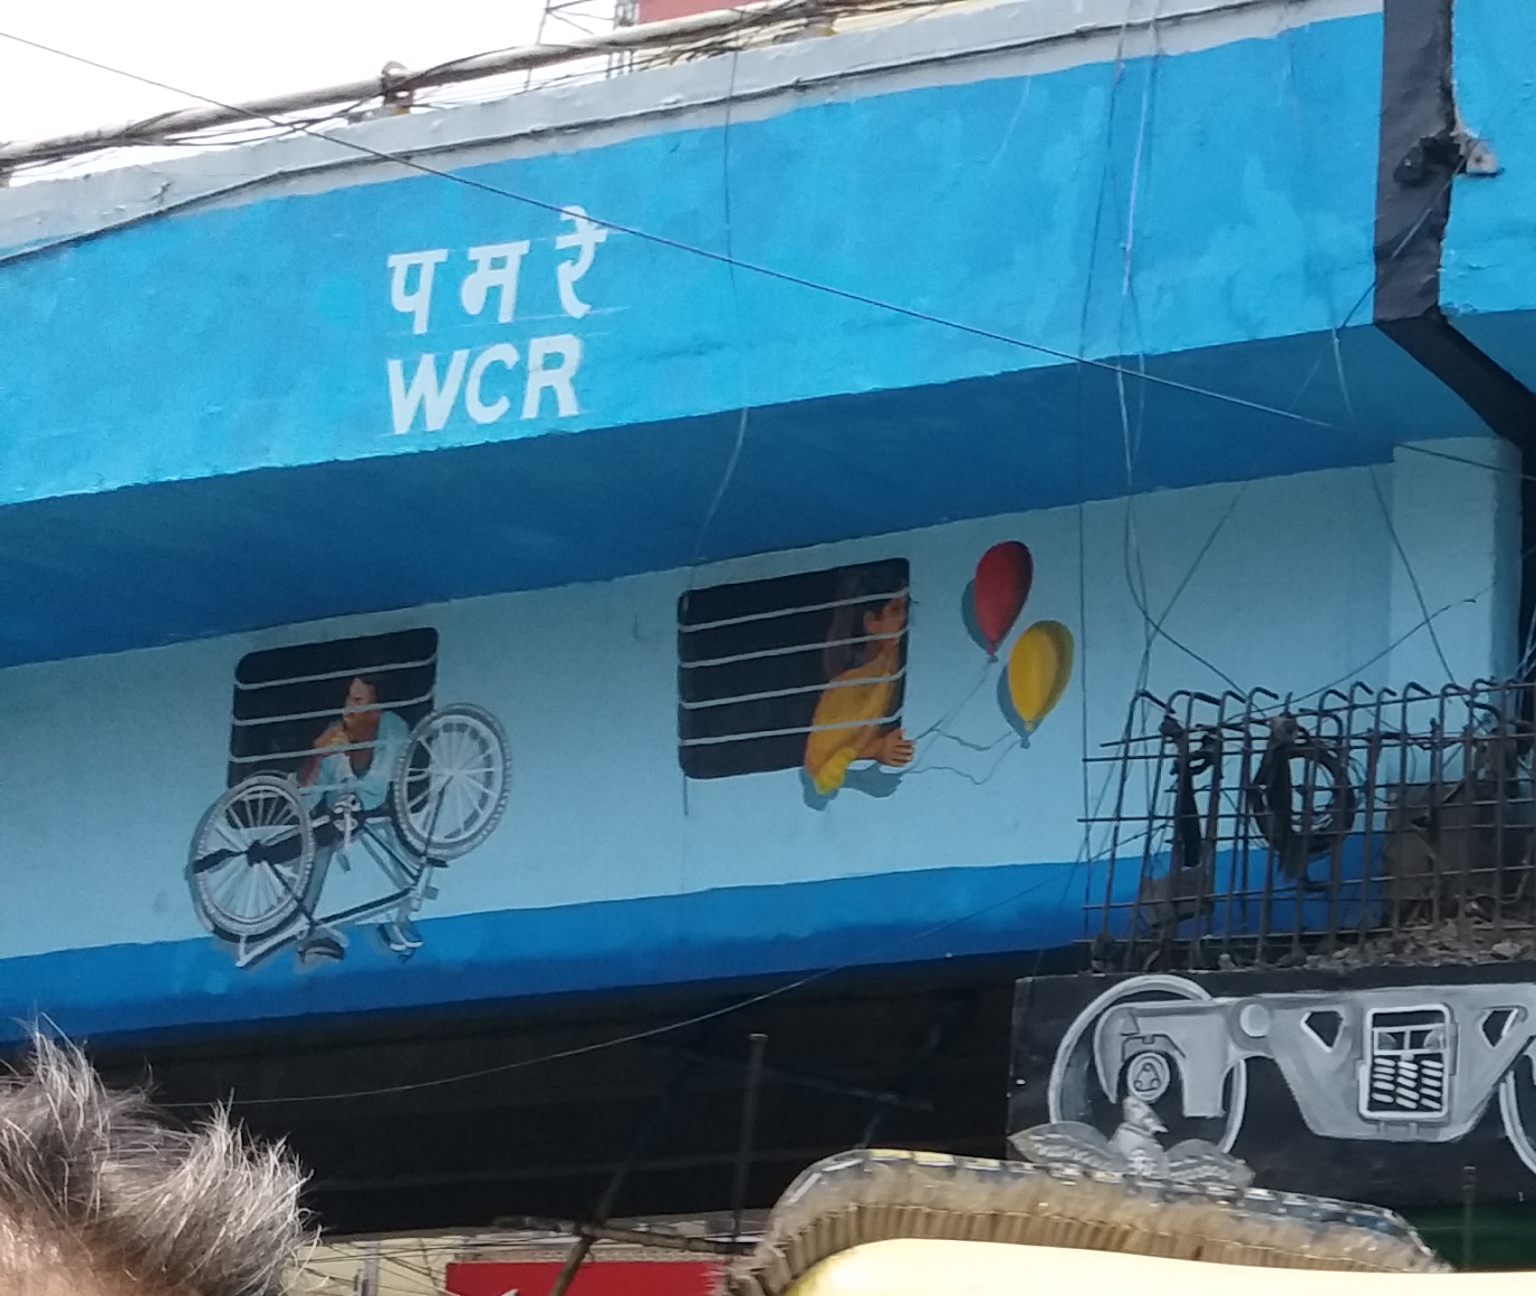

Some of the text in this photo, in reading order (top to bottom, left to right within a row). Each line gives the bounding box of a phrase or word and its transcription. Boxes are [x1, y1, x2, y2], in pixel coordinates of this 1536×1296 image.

[387, 248, 449, 335] प
[460, 240, 530, 324] म
[387, 333, 582, 435] WCR
